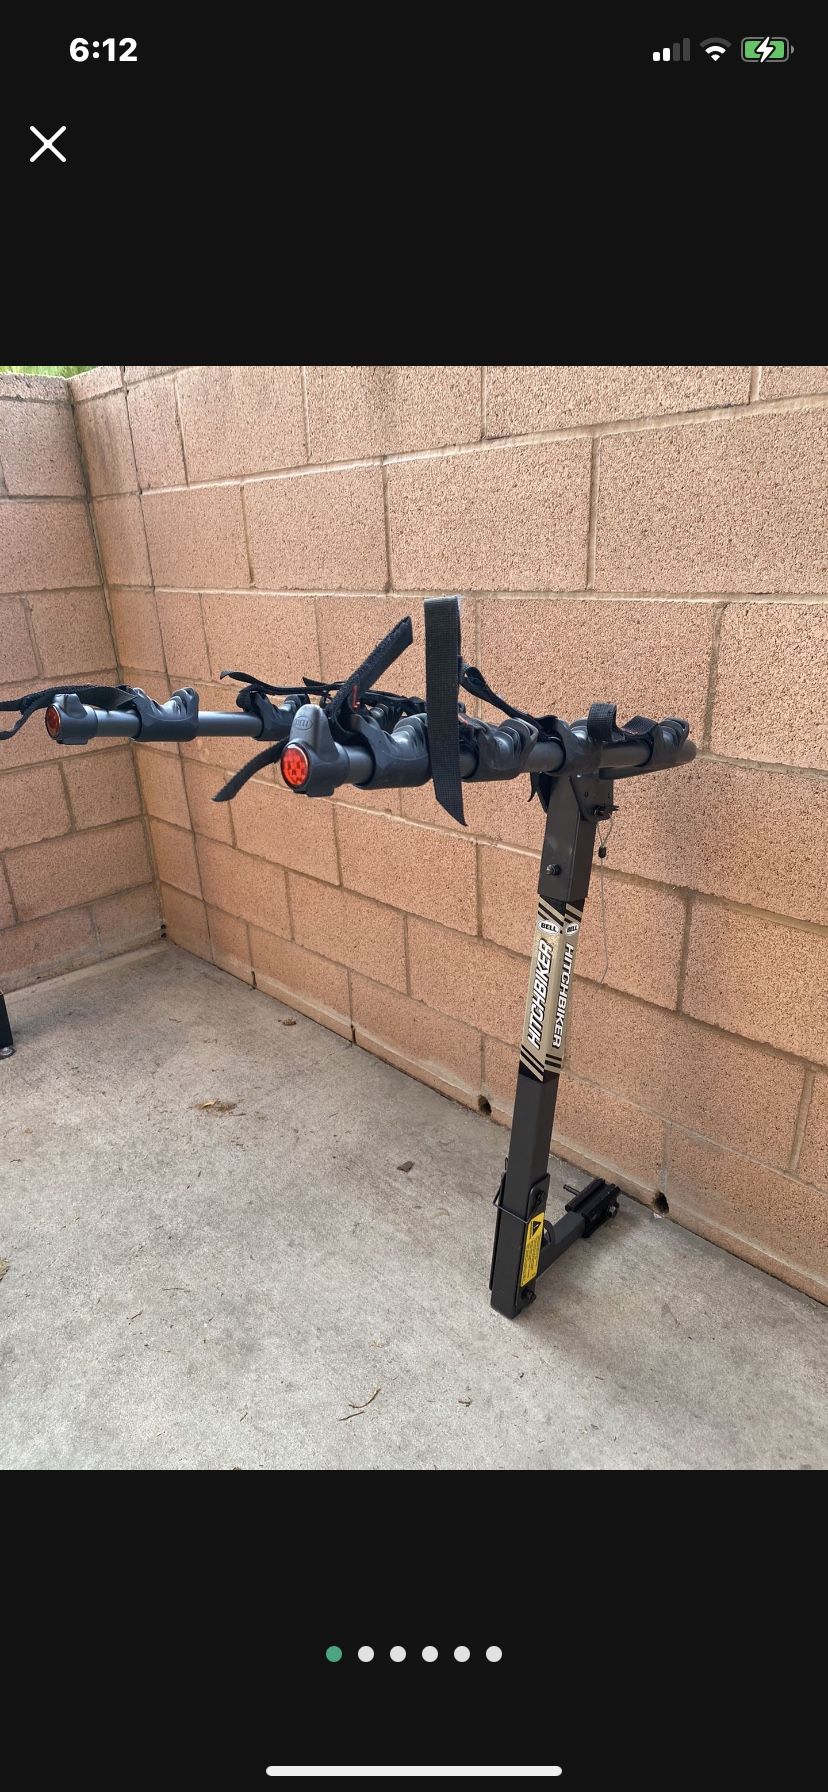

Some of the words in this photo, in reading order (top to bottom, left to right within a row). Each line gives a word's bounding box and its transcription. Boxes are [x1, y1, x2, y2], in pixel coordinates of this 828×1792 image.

[540, 922, 557, 932] BELL
[566, 925, 578, 933] BELL
[527, 937, 553, 1050] HITCHBIKER
[552, 942, 574, 1049] HITCHBIKER
